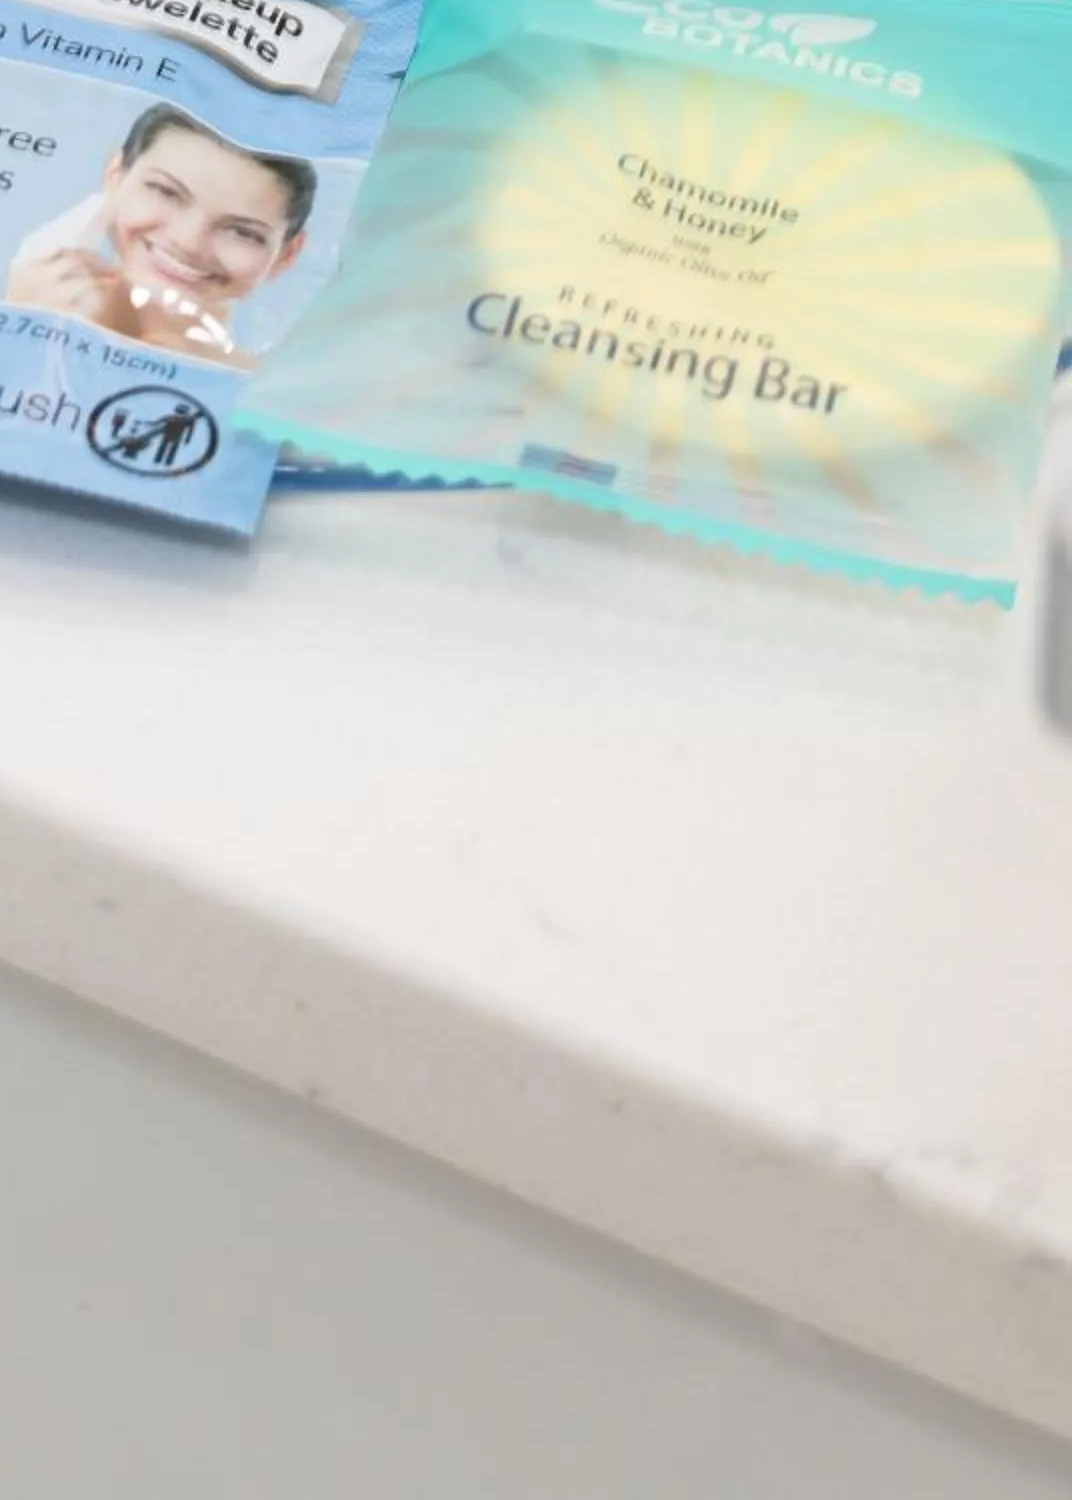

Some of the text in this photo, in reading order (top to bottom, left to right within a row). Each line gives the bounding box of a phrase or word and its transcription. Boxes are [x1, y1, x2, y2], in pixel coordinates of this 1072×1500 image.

[20, 21, 145, 74] Vitamin
[154, 56, 182, 83] E
[642, 15, 924, 100] BOTANICS
[616, 152, 801, 225] Chamomile
[631, 186, 768, 246] & Honey
[558, 284, 778, 351] REFRESHING
[76, 339, 92, 355] x
[100, 345, 178, 382] 15cm)
[465, 291, 850, 417] Cleansing Bar
